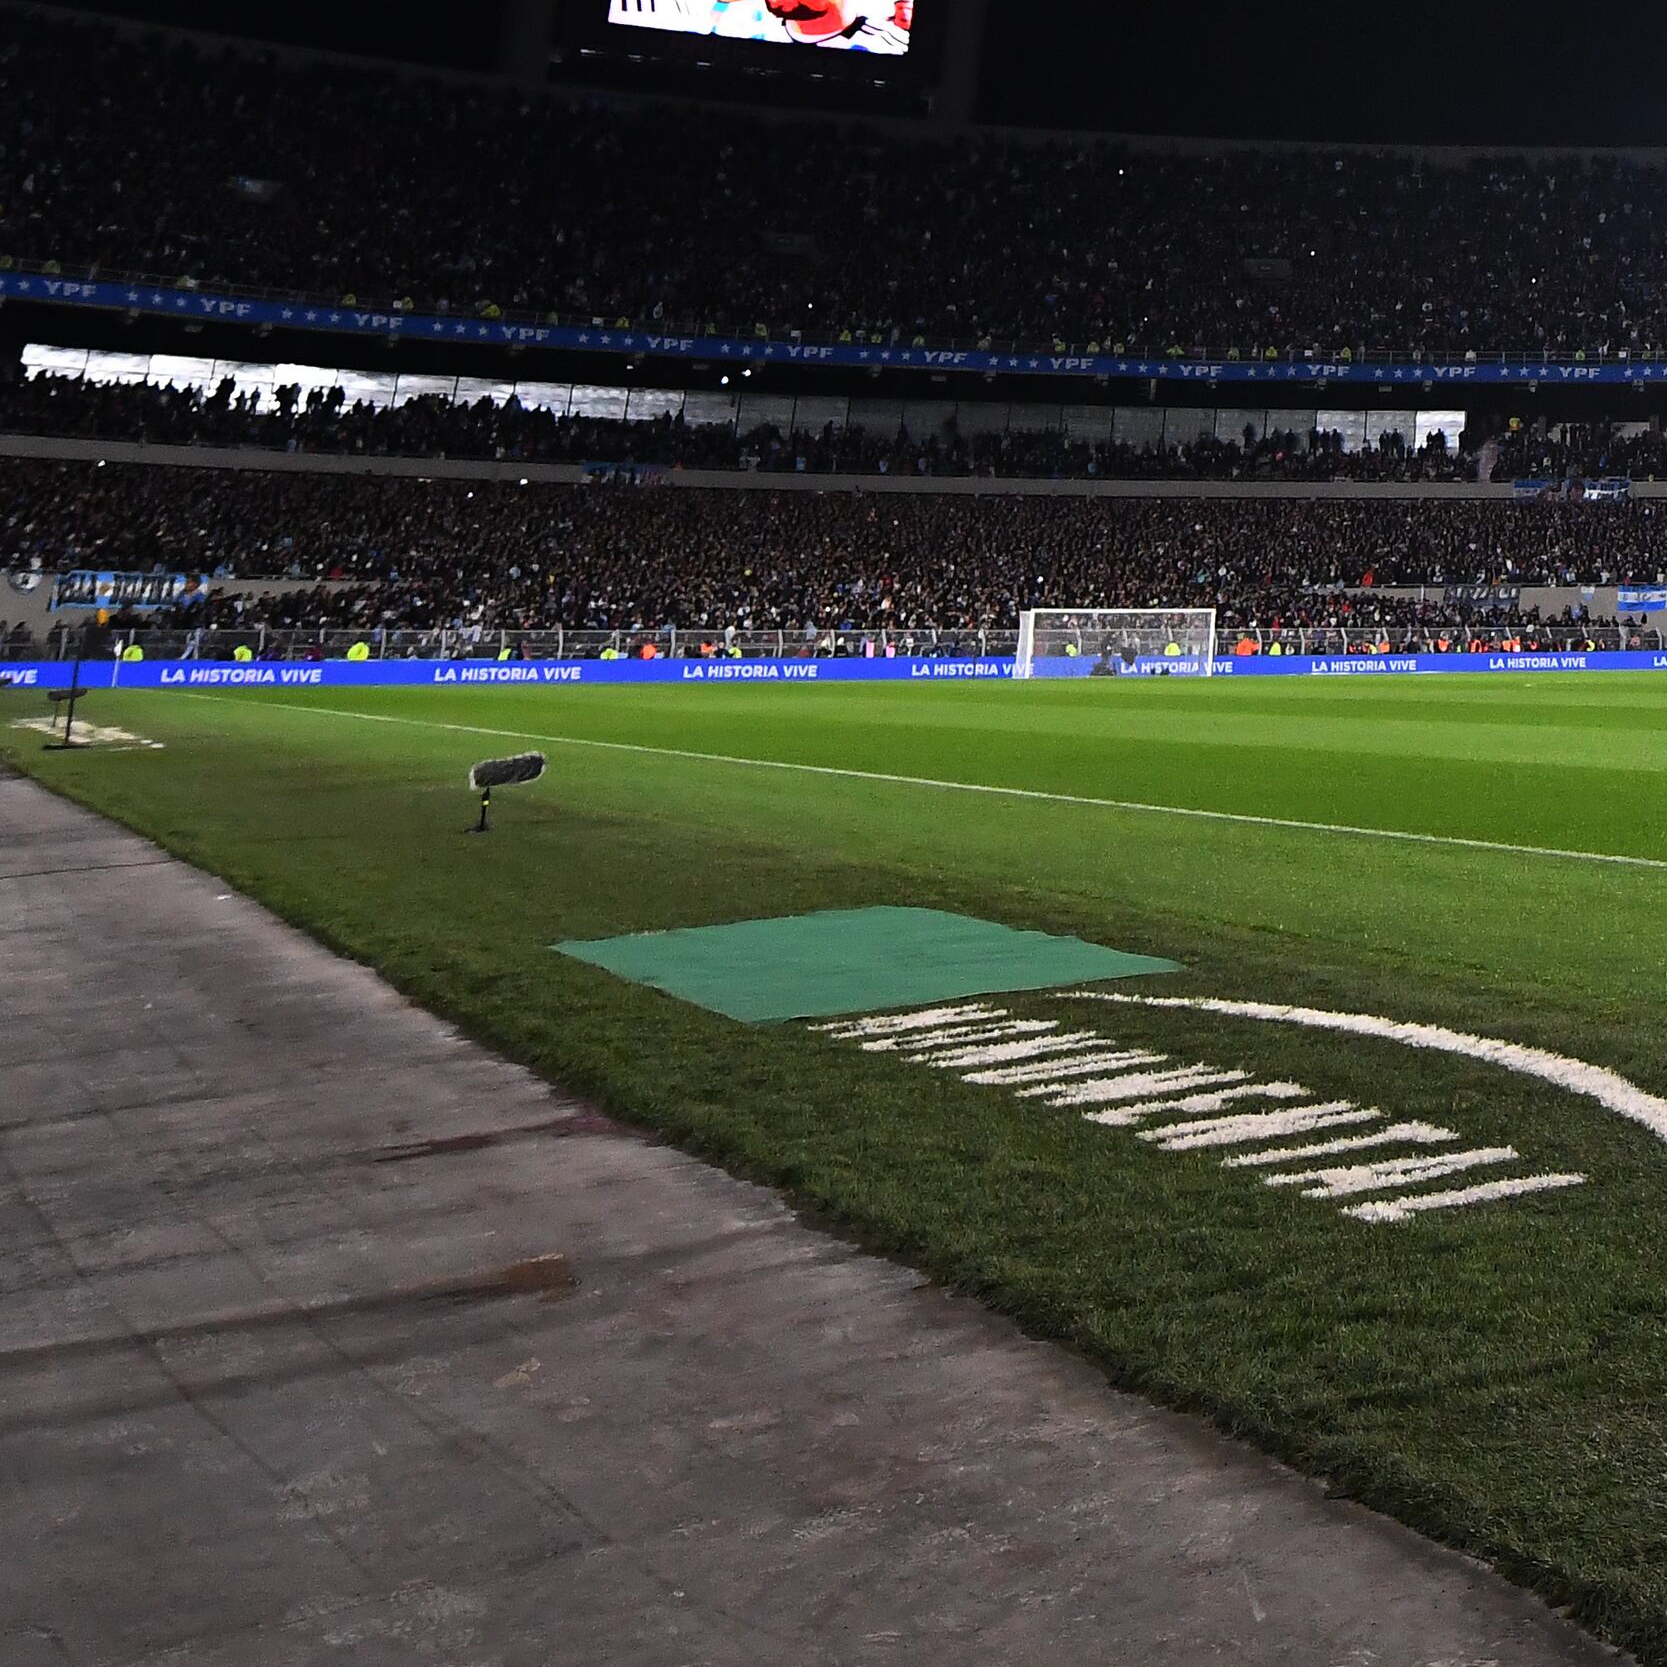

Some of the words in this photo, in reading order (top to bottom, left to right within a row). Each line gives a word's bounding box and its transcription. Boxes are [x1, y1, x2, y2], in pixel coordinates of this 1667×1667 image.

[44, 281, 96, 297] YPF
[201, 299, 250, 316] YPF
[355, 314, 402, 328] YPF
[502, 327, 549, 341] YPF
[648, 337, 693, 350] YPF
[788, 346, 833, 358] YPF
[924, 352, 967, 363] YPF
[1051, 358, 1093, 369] YPF
[1180, 365, 1222, 376] YPF
[1307, 365, 1349, 376] YPF
[1434, 367, 1475, 377] YPF
[1560, 367, 1600, 378] YPF
[1311, 661, 1327, 672] LA
[1331, 661, 1387, 672] HISTORIA
[1389, 660, 1417, 671] VIVE
[1490, 658, 1504, 669] LA
[1508, 658, 1558, 669] HISTORIA
[1561, 657, 1586, 668] VIVE
[1654, 656, 1667, 667] LA
[435, 669, 456, 681] LA
[461, 668, 538, 681] HISTORIA
[544, 667, 581, 680] VIVE
[683, 666, 703, 678] LA
[707, 665, 778, 678] HISTORIA
[783, 665, 817, 678] VIVE
[912, 665, 930, 676] LA
[934, 664, 998, 676] HISTORIA
[1121, 662, 1138, 674] LA
[161, 669, 185, 682] LA
[191, 669, 275, 682] HISTORIA
[280, 669, 322, 683] VIVE
